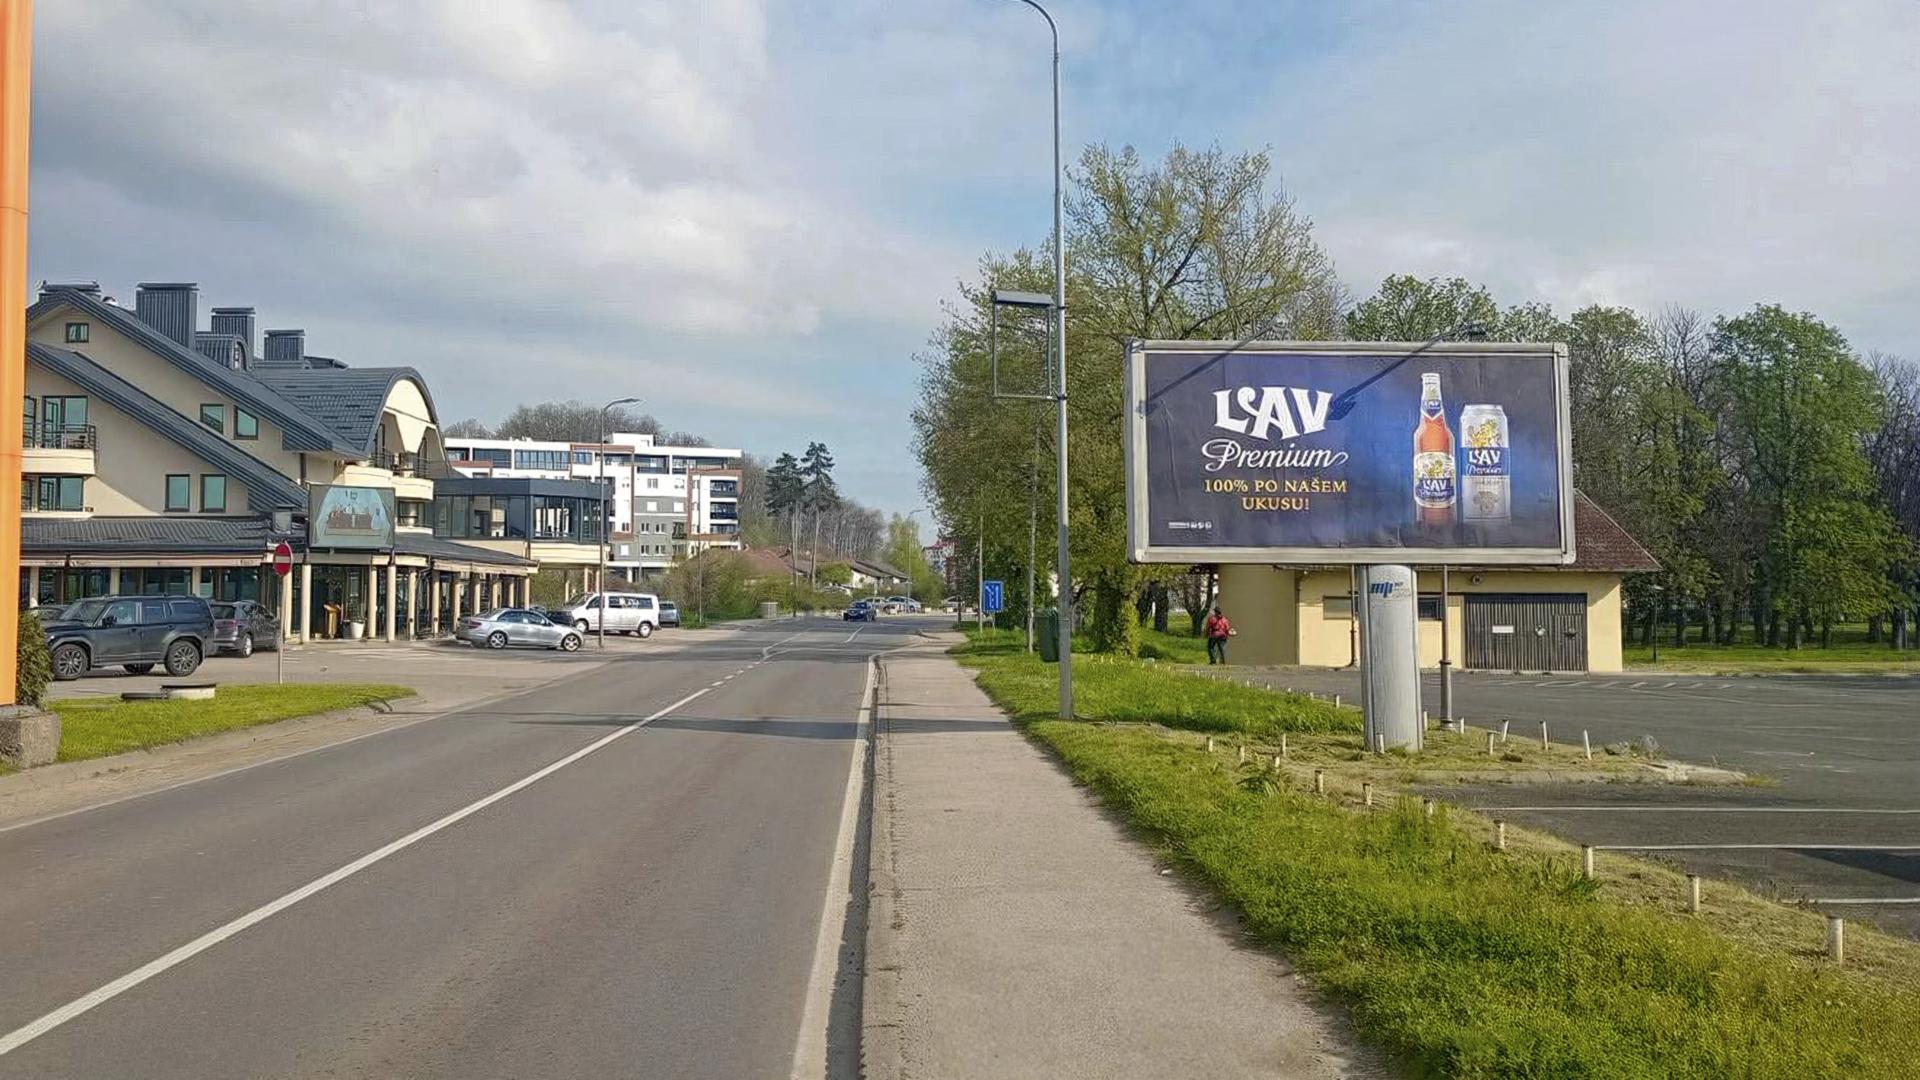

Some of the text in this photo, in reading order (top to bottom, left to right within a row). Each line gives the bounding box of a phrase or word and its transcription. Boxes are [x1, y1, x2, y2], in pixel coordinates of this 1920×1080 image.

[1213, 386, 1333, 440] LAV
[1201, 438, 1349, 472] Premium
[1468, 449, 1500, 465] LAV
[1204, 476, 1347, 493] 100% PO NAŠEM
[1242, 496, 1309, 511] UKUSU!
